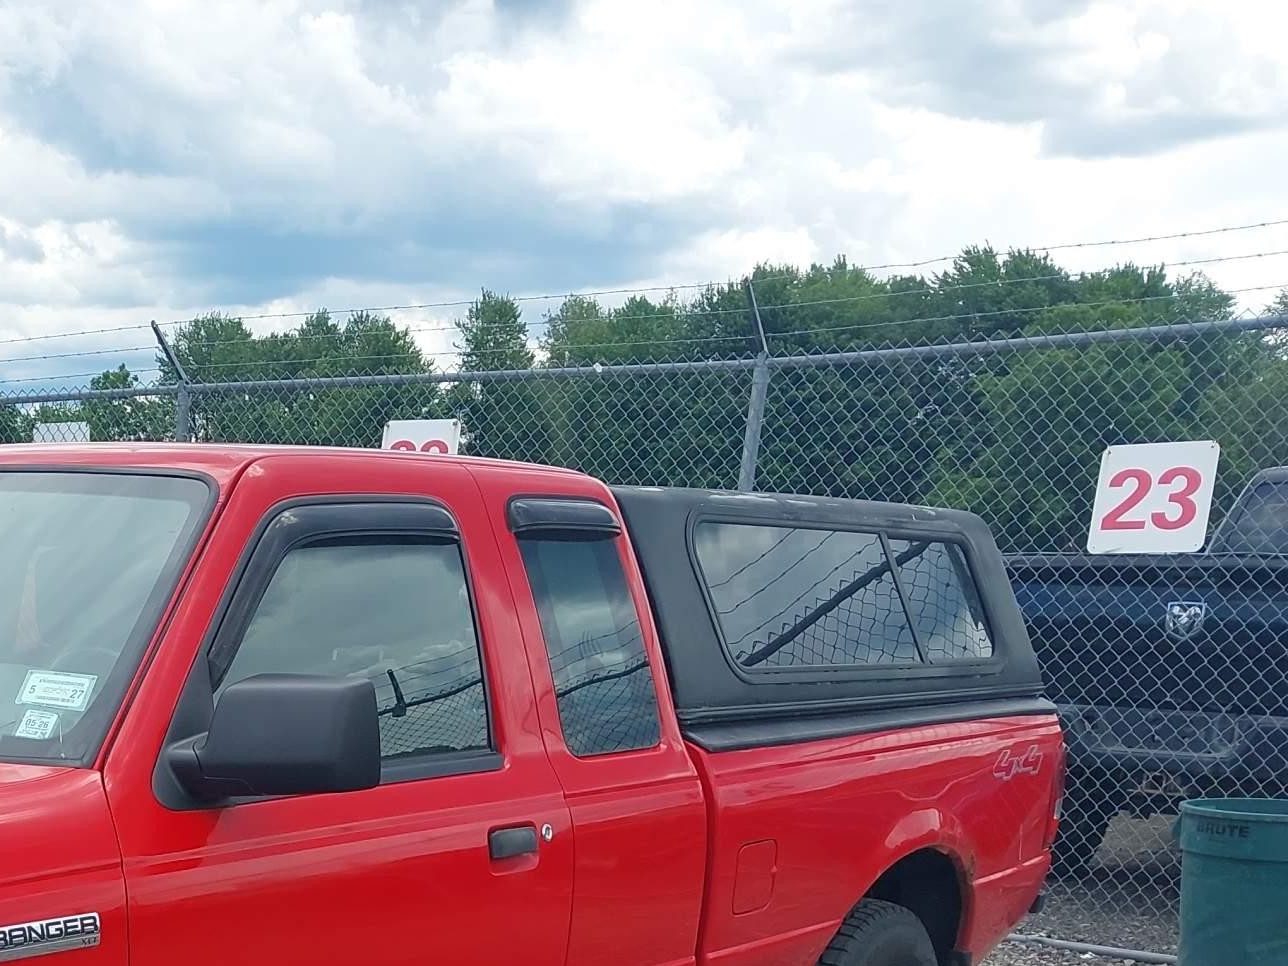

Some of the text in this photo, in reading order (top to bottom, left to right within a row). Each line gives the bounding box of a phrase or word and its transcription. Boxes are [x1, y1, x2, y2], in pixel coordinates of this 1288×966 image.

[1100, 466, 1202, 531] 23
[28, 684, 38, 694] 5
[69, 688, 85, 700] 27
[992, 744, 1044, 781] 4x4
[1196, 822, 1250, 838] BRUTE
